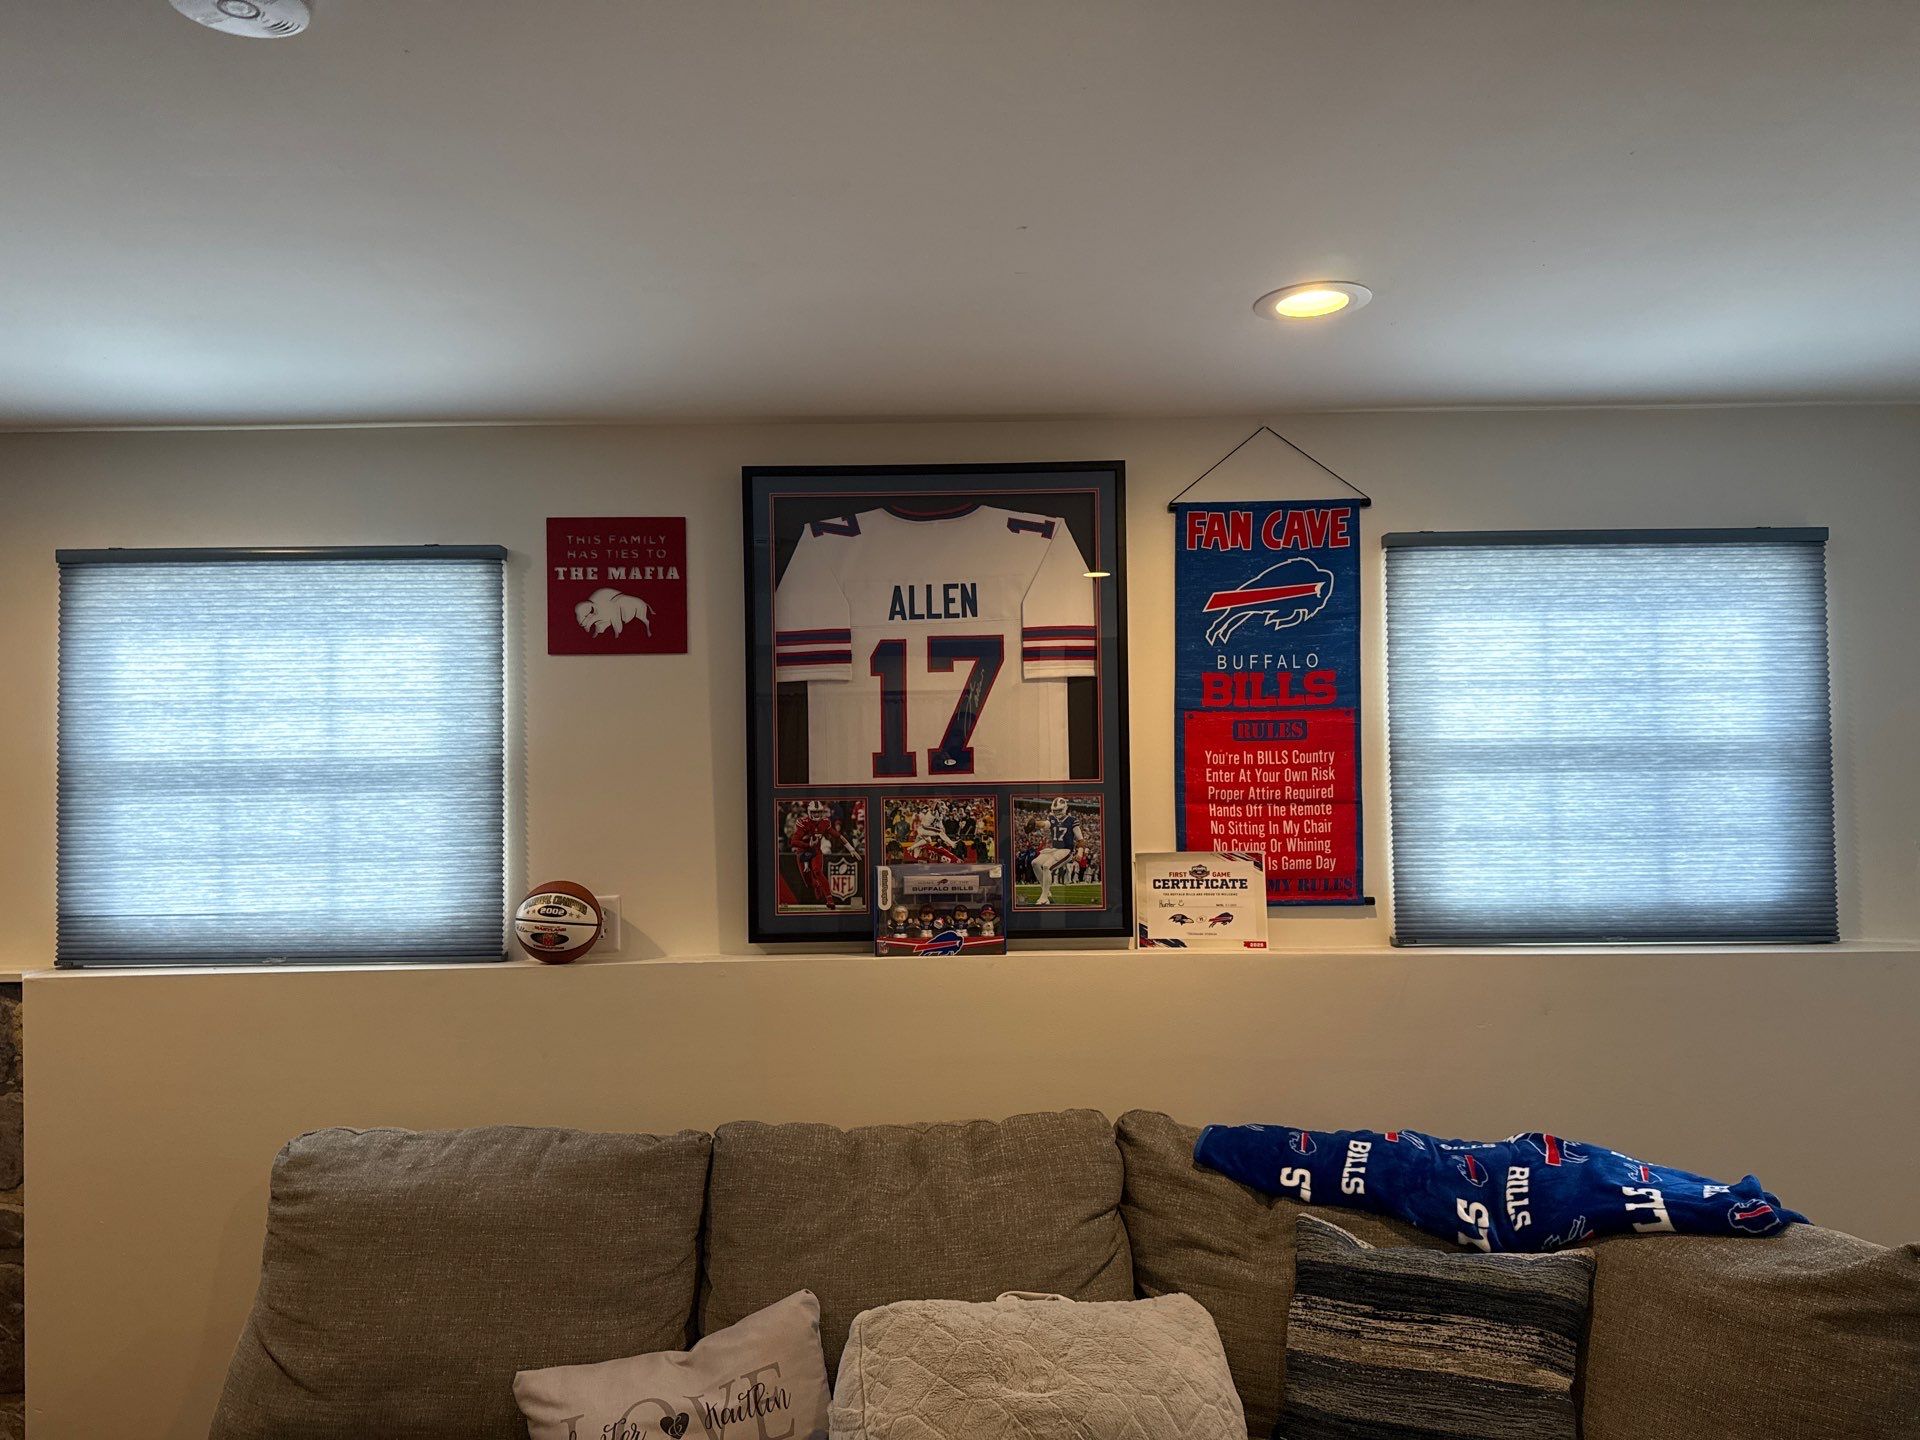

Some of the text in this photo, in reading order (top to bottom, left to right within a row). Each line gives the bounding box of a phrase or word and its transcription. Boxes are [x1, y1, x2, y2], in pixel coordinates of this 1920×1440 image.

[1187, 507, 1351, 552] FAN CAVE
[566, 534, 667, 545] THIS FAMILY
[567, 549, 667, 559] HAS TIES TO
[554, 566, 680, 581] THE MAFIA
[888, 582, 979, 621] ALLEN
[1217, 653, 1319, 670] BUFFALO
[1201, 669, 1337, 708] BILLS
[869, 634, 1005, 779] 17
[1237, 721, 1304, 740] RULES
[1204, 749, 1335, 766] You're In BILLS Country
[1206, 766, 1335, 783] Enter At Your Own Risk
[1208, 784, 1334, 804] Proper Attire Required
[1209, 802, 1332, 818] Hands Off The Remote
[1052, 826, 1068, 842] 17
[1210, 819, 1332, 838] No Sitting In My Chair
[1213, 837, 1331, 854] No Crying Or Whining
[1268, 854, 1336, 872] Is Game Day
[832, 876, 854, 894] NFL
[1152, 878, 1248, 890] CERTIFICATE
[1297, 877, 1353, 892] RULES
[540, 907, 565, 915] 2002
[1341, 1140, 1372, 1195] BILLS
[1506, 1166, 1532, 1231] BILLS
[704, 1382, 791, 1430] Kaitlin
